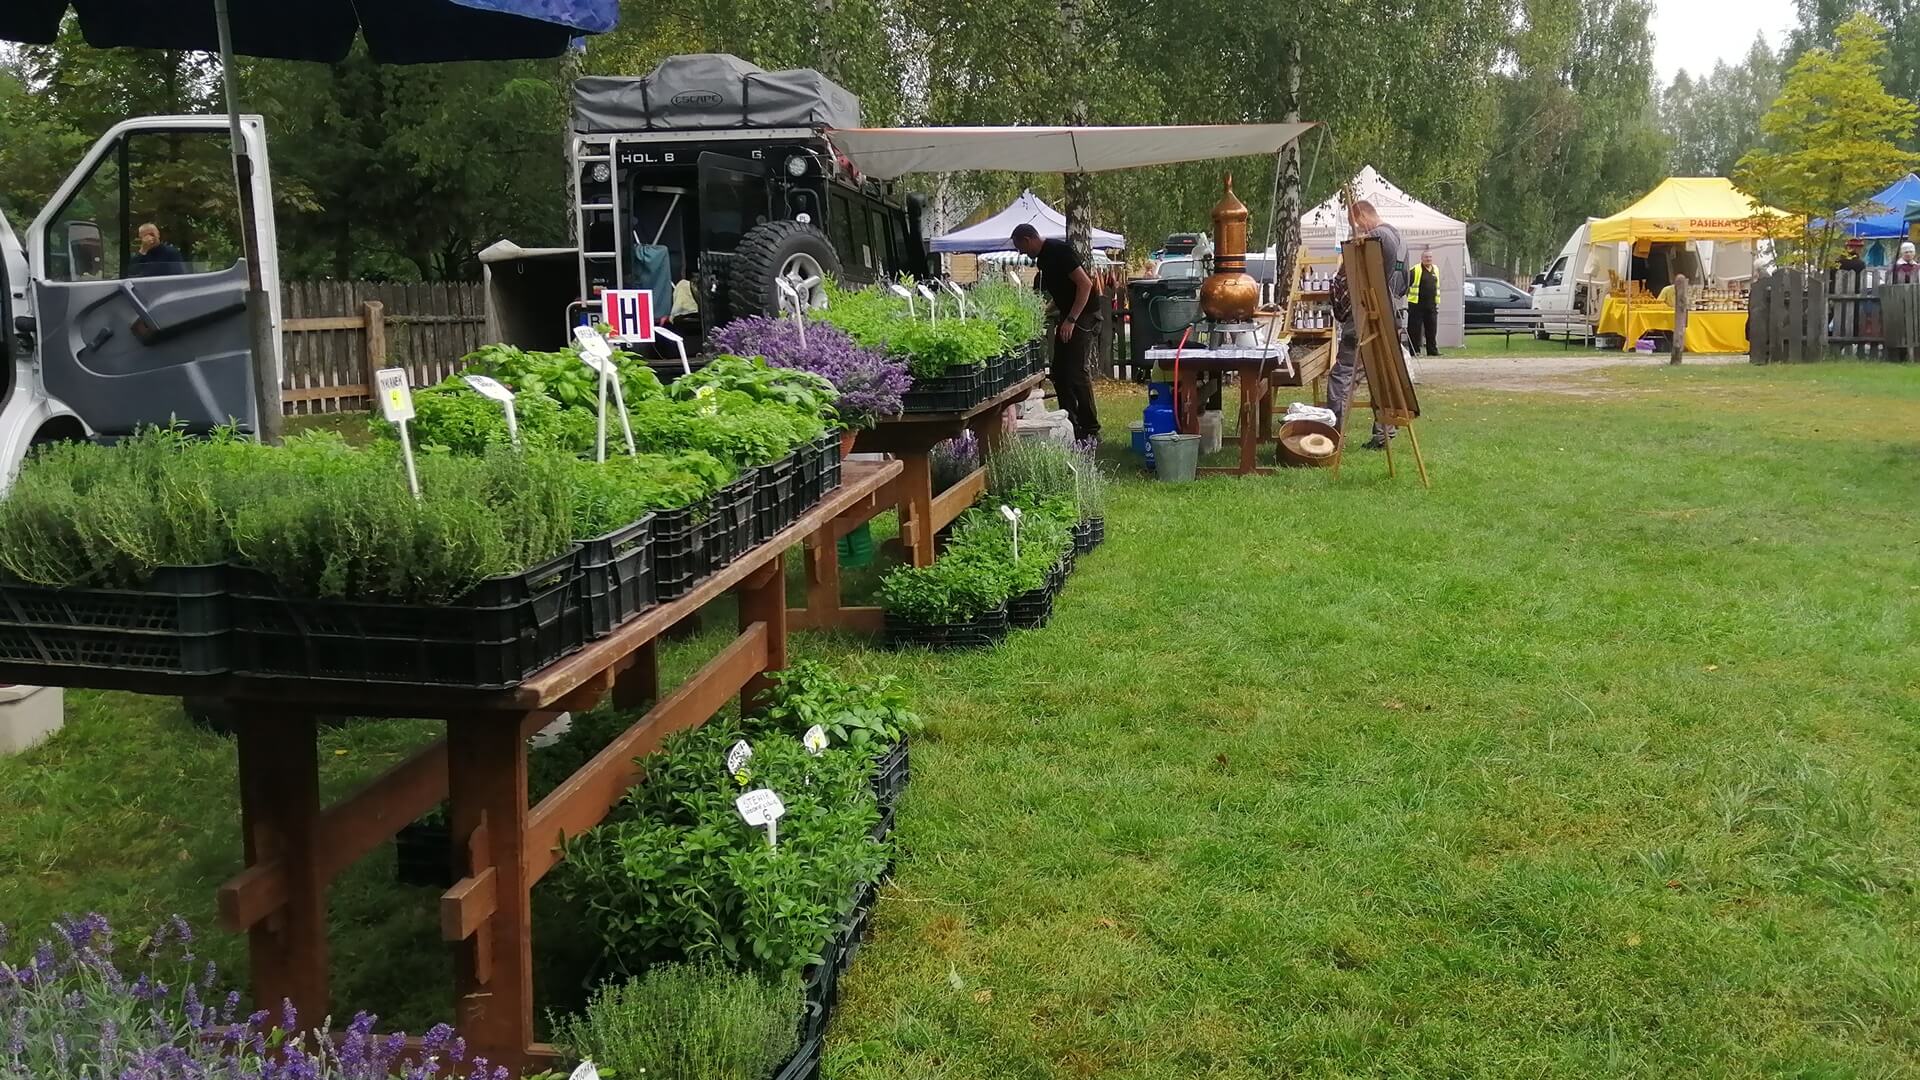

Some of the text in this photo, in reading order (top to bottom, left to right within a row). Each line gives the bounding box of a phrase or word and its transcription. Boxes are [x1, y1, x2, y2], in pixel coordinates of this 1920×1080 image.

[675, 95, 718, 105] ESCAPE
[621, 153, 658, 164] HOL.
[1689, 219, 1731, 228] PASIEKA
[620, 298, 639, 335] H
[762, 808, 772, 821] 6
